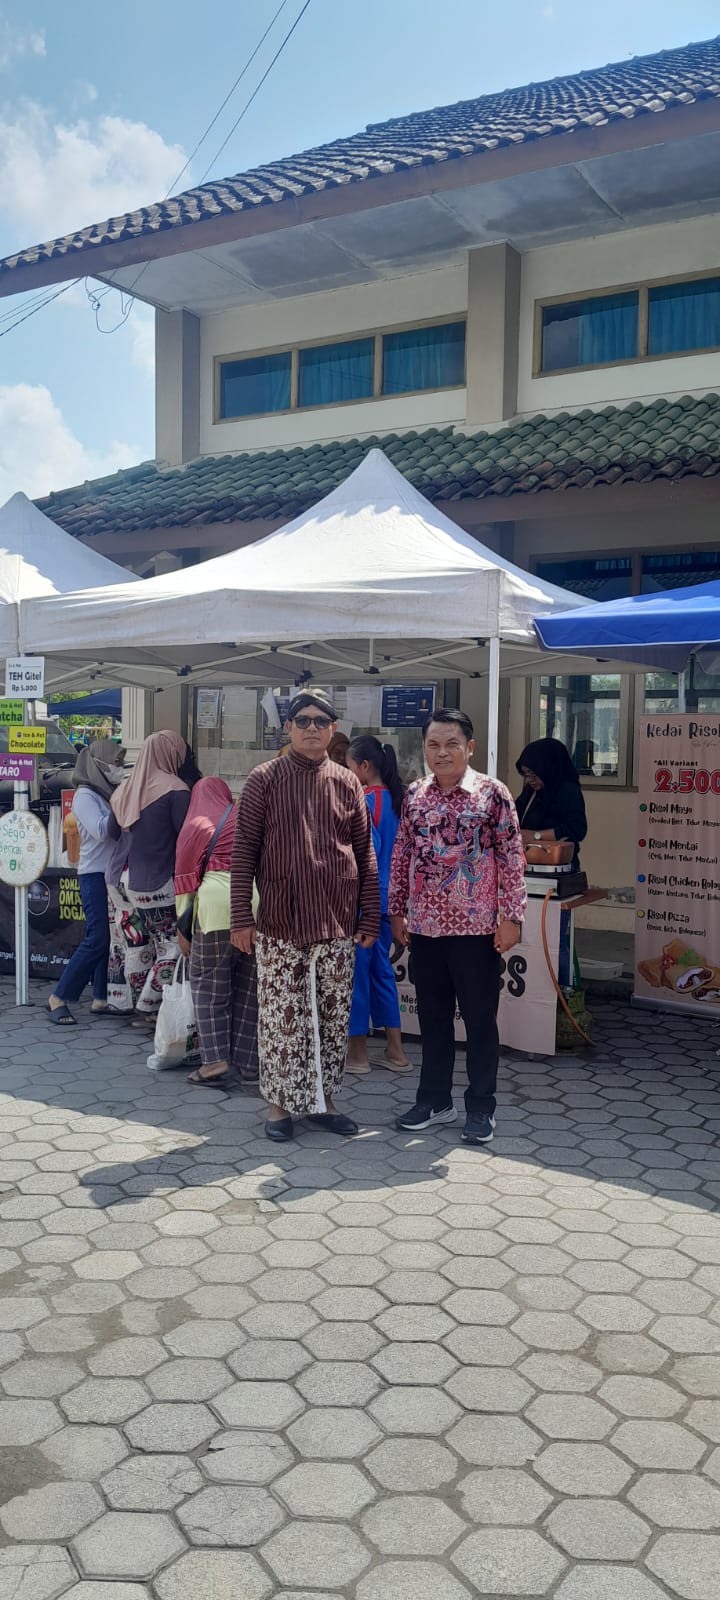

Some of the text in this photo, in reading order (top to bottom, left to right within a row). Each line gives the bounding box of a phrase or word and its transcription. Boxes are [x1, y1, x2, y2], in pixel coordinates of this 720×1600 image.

[9, 672, 22, 680] TEH
[12, 684, 19, 692] Rp
[0, 711, 22, 721] tcha
[646, 722, 683, 738] Kedai
[10, 740, 45, 749] Chocolate
[669, 759, 699, 767] Variant
[649, 802, 693, 815] Risol Mayo
[2, 824, 26, 842] Sego
[648, 838, 699, 851] Risol Mentai
[59, 878, 80, 890] COKL
[647, 873, 668, 886] Risol
[668, 875, 700, 888] Chicken
[59, 890, 82, 905] OMA
[646, 908, 690, 924] Risol Pizza
